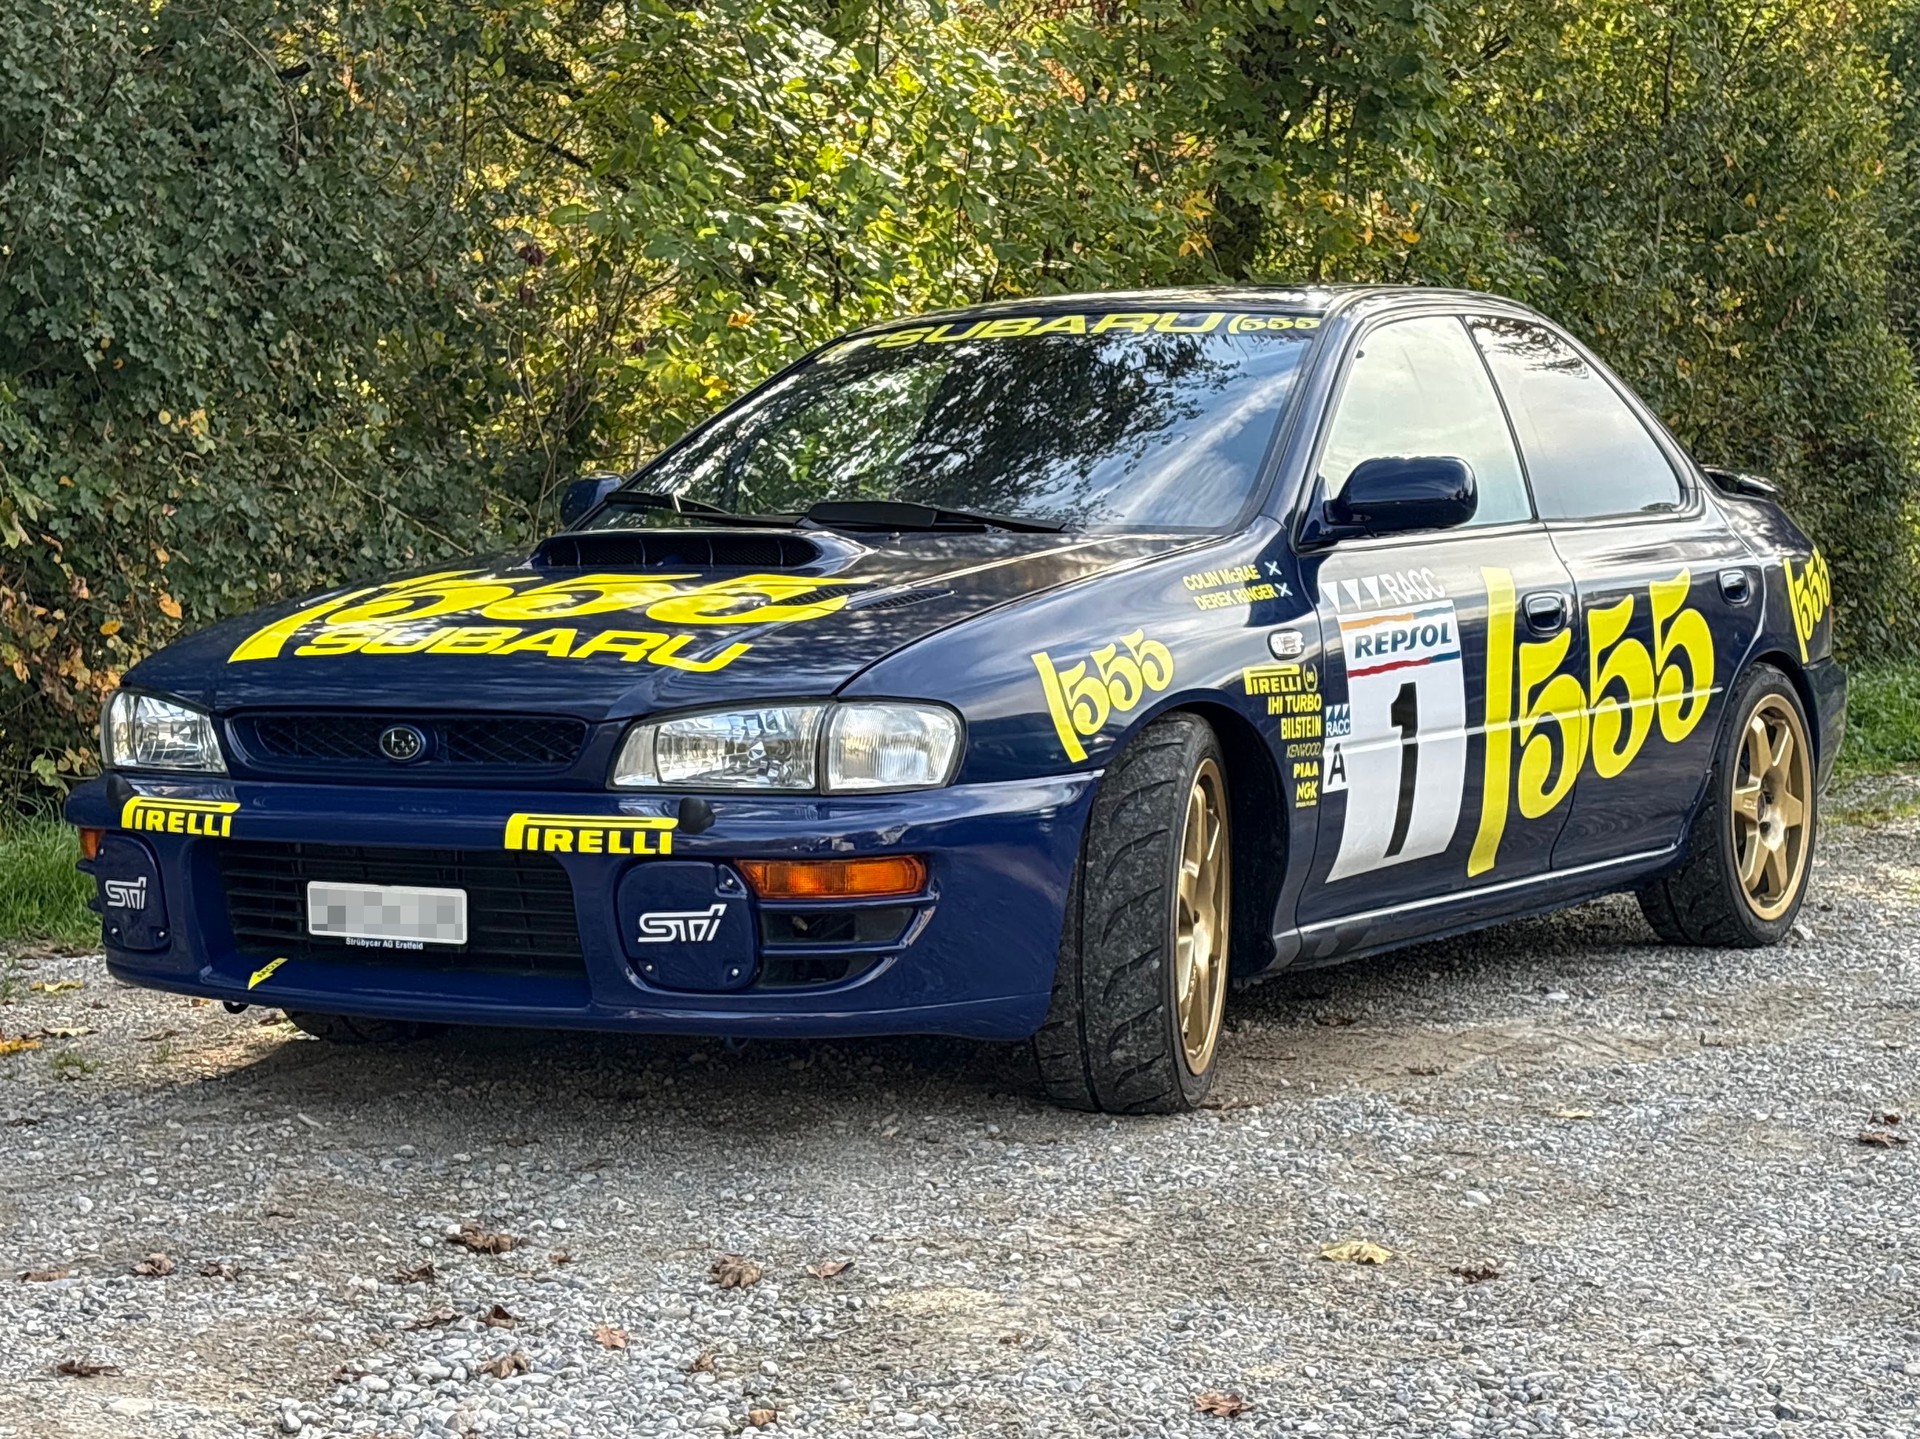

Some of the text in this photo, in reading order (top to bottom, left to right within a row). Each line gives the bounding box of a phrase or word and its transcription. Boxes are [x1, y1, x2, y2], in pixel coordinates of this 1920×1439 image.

[875, 312, 1226, 348] SUBARU
[1183, 564, 1261, 591] COLIN McRAE
[1378, 567, 1446, 605] RACC
[1193, 583, 1279, 611] DEREK RINGER
[294, 626, 754, 673] SUBARU
[1354, 622, 1453, 660] REPSOL
[1242, 663, 1302, 695] PIRELLI
[1267, 693, 1322, 716] IHI TURBO
[1280, 715, 1322, 740] BILSTEIN
[1325, 719, 1351, 737] RACC
[1286, 741, 1322, 759] KENWOOD
[1327, 742, 1347, 786] A
[1293, 761, 1319, 779] PIAA
[1383, 681, 1419, 859] 1
[1296, 780, 1319, 801] NGK
[121, 796, 241, 838] PIRELLI
[504, 812, 679, 855] PIRELLI
[382, 939, 394, 949] AG
